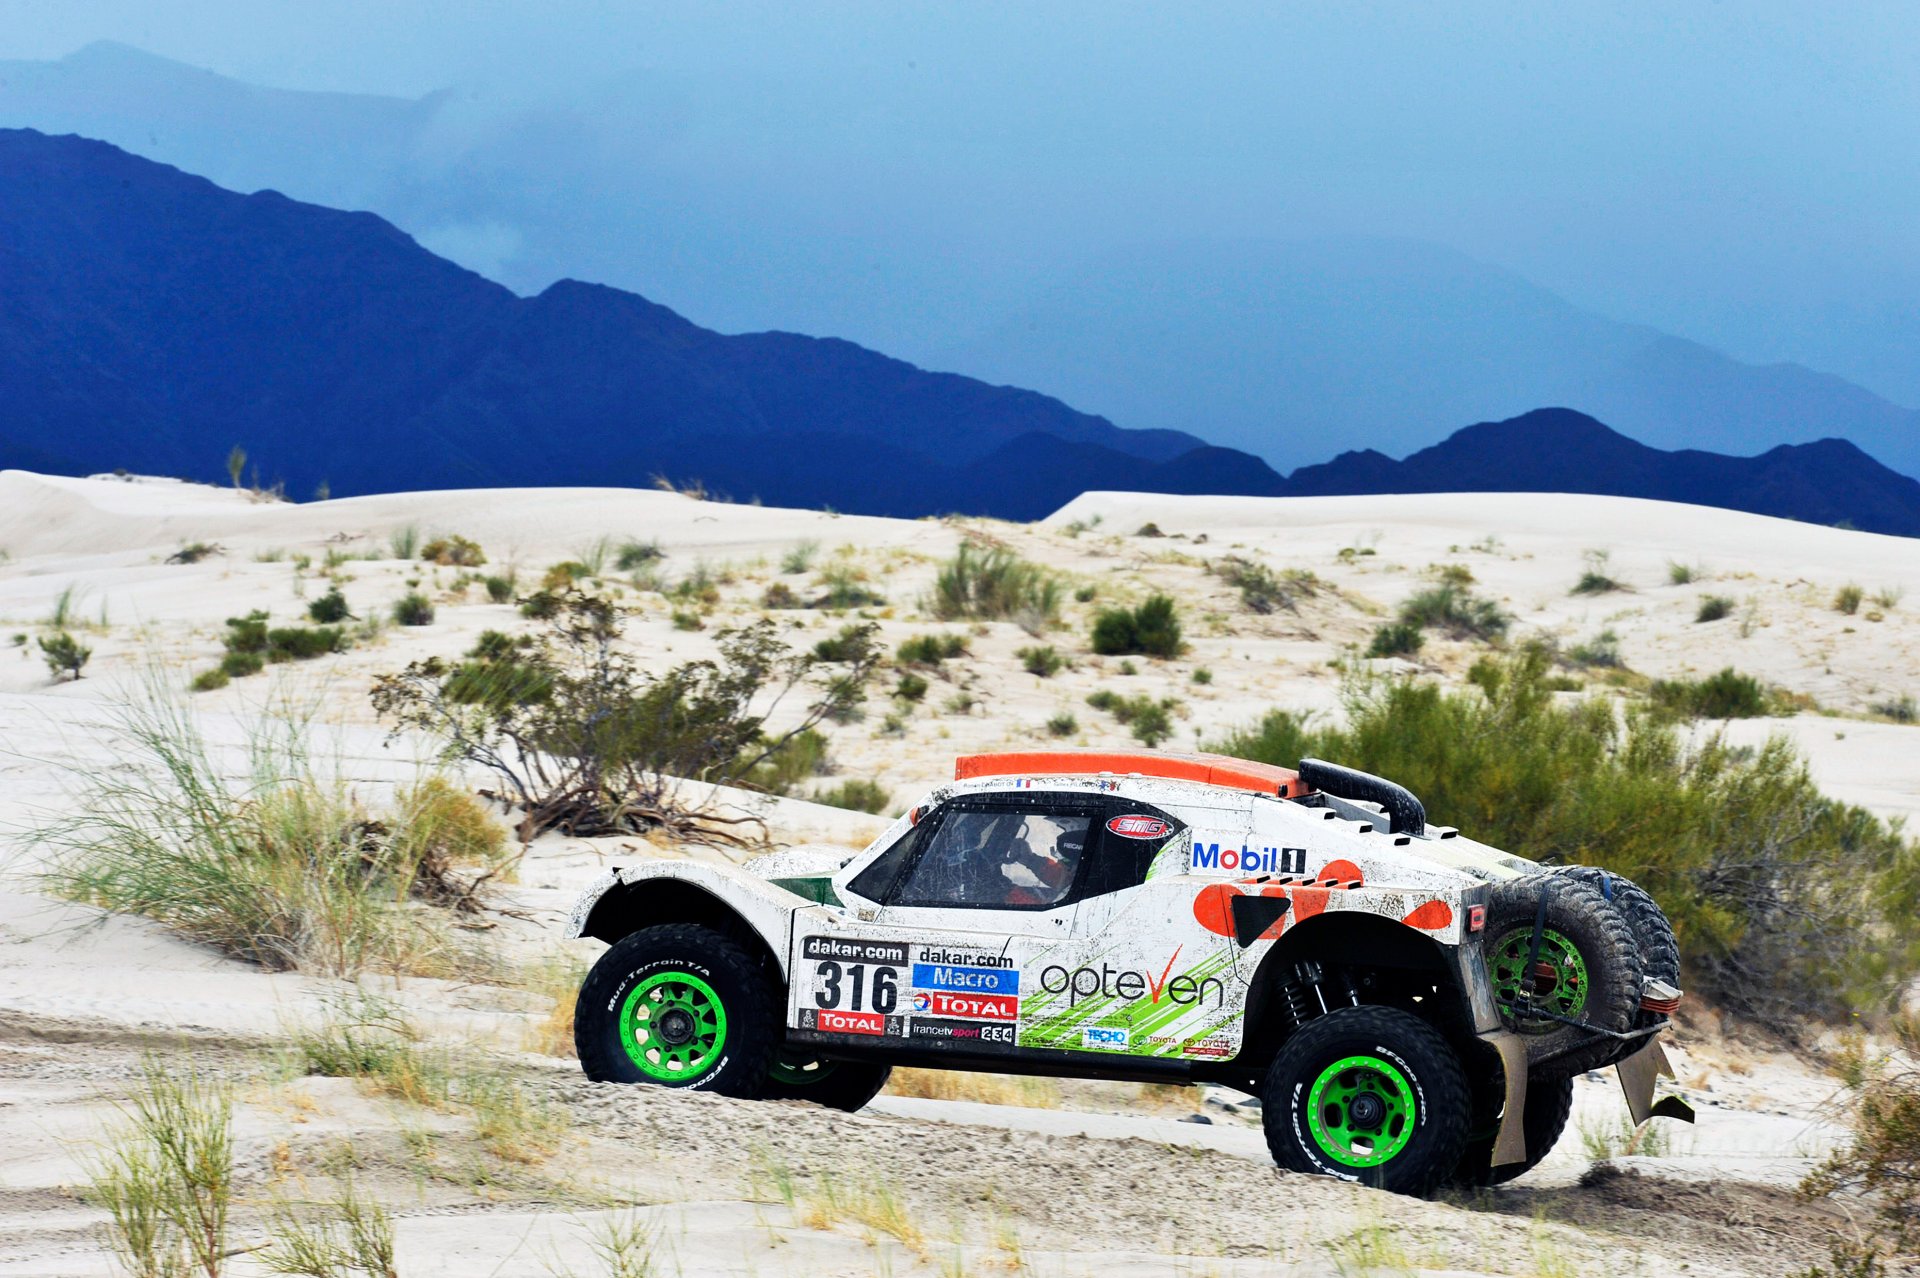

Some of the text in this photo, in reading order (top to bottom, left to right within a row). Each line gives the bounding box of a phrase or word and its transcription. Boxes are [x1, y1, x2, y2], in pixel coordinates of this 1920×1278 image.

[1116, 819, 1165, 834] SMG
[1192, 842, 1277, 873] Mobil
[809, 938, 903, 961] dakar.com
[919, 948, 1013, 968] dakar.com
[607, 959, 710, 1012] Mud-Terrain T/A
[933, 967, 999, 988] Macro
[815, 961, 898, 1015] 316
[936, 994, 1014, 1017] TOTAL
[821, 1013, 882, 1031] TOTAL
[1088, 1029, 1126, 1043] TECHO
[1149, 1035, 1177, 1044] TOYOTA
[1197, 1039, 1231, 1049] TOYOTA
